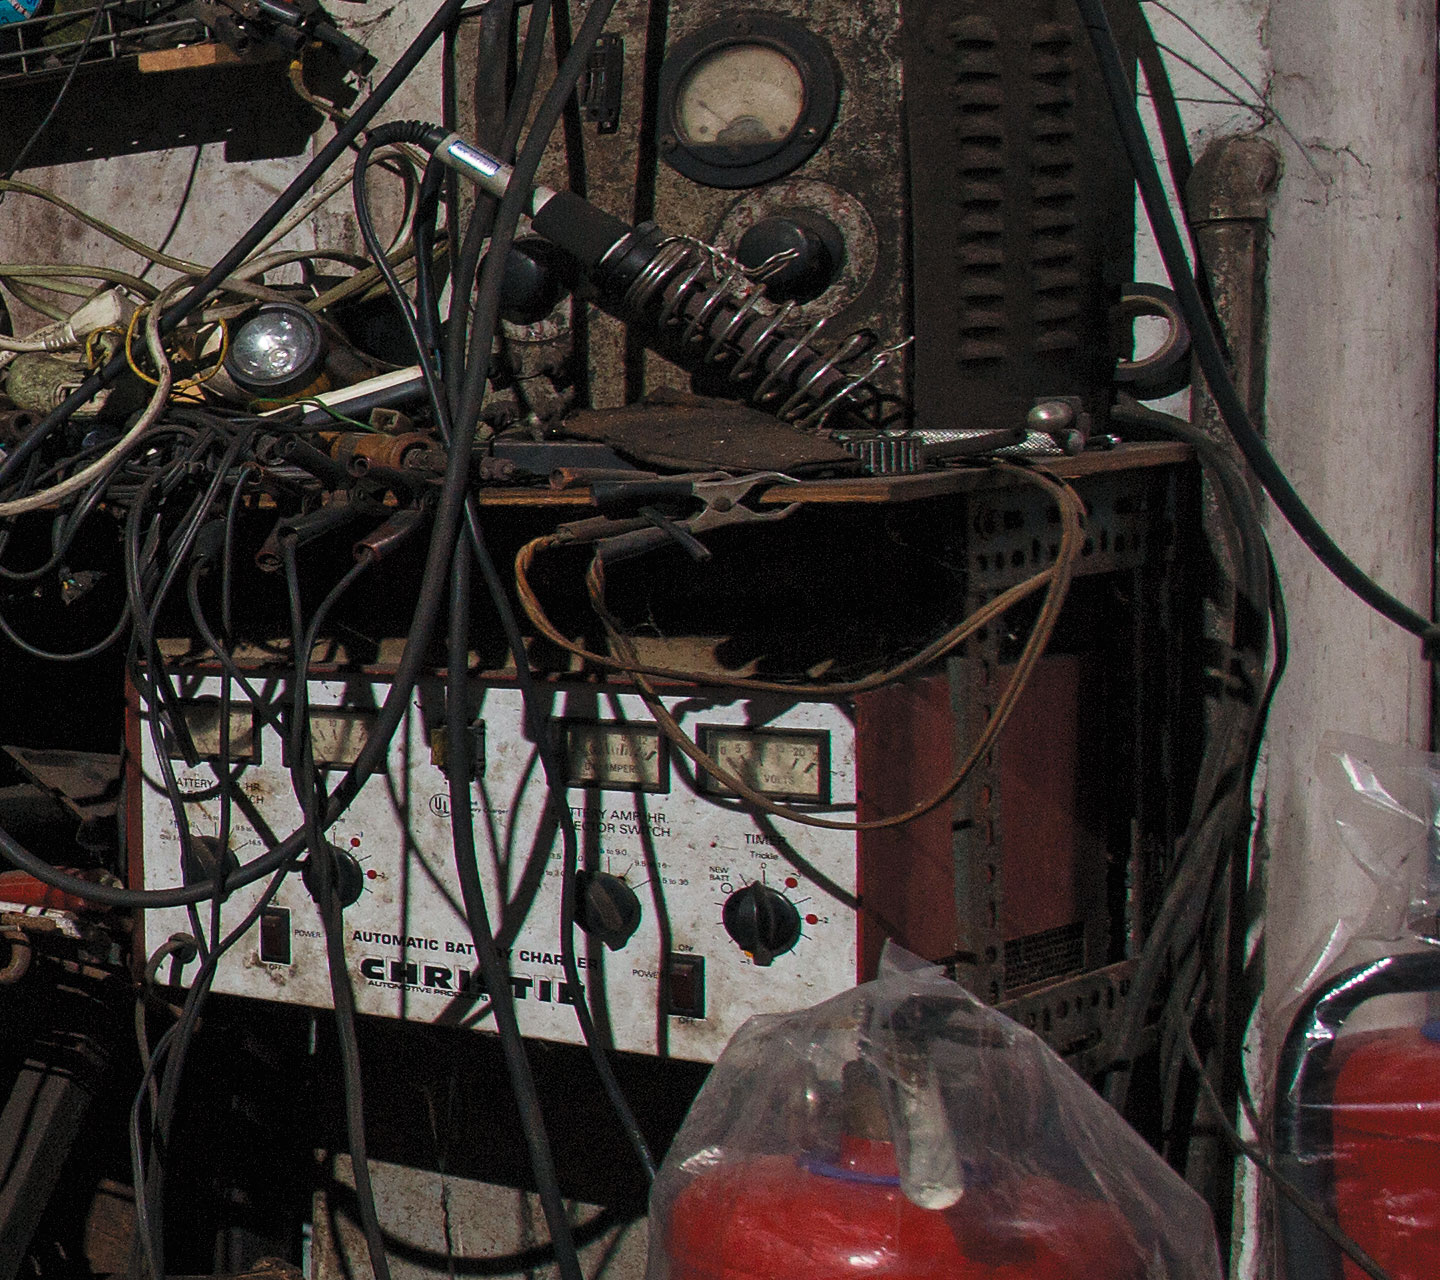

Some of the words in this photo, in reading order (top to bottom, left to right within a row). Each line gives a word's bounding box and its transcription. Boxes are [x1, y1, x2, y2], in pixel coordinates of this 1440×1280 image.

[175, 777, 214, 789] ATTERY
[744, 833, 786, 845] TIMER
[750, 850, 779, 860] Trickle
[709, 866, 730, 874] NEW
[294, 930, 322, 939] POWER
[352, 930, 439, 951] AUTOMATIC
[519, 949, 598, 970] CHARER
[367, 979, 434, 994] AUTOMOTIVE
[434, 988, 489, 1003] PRODUCTS
